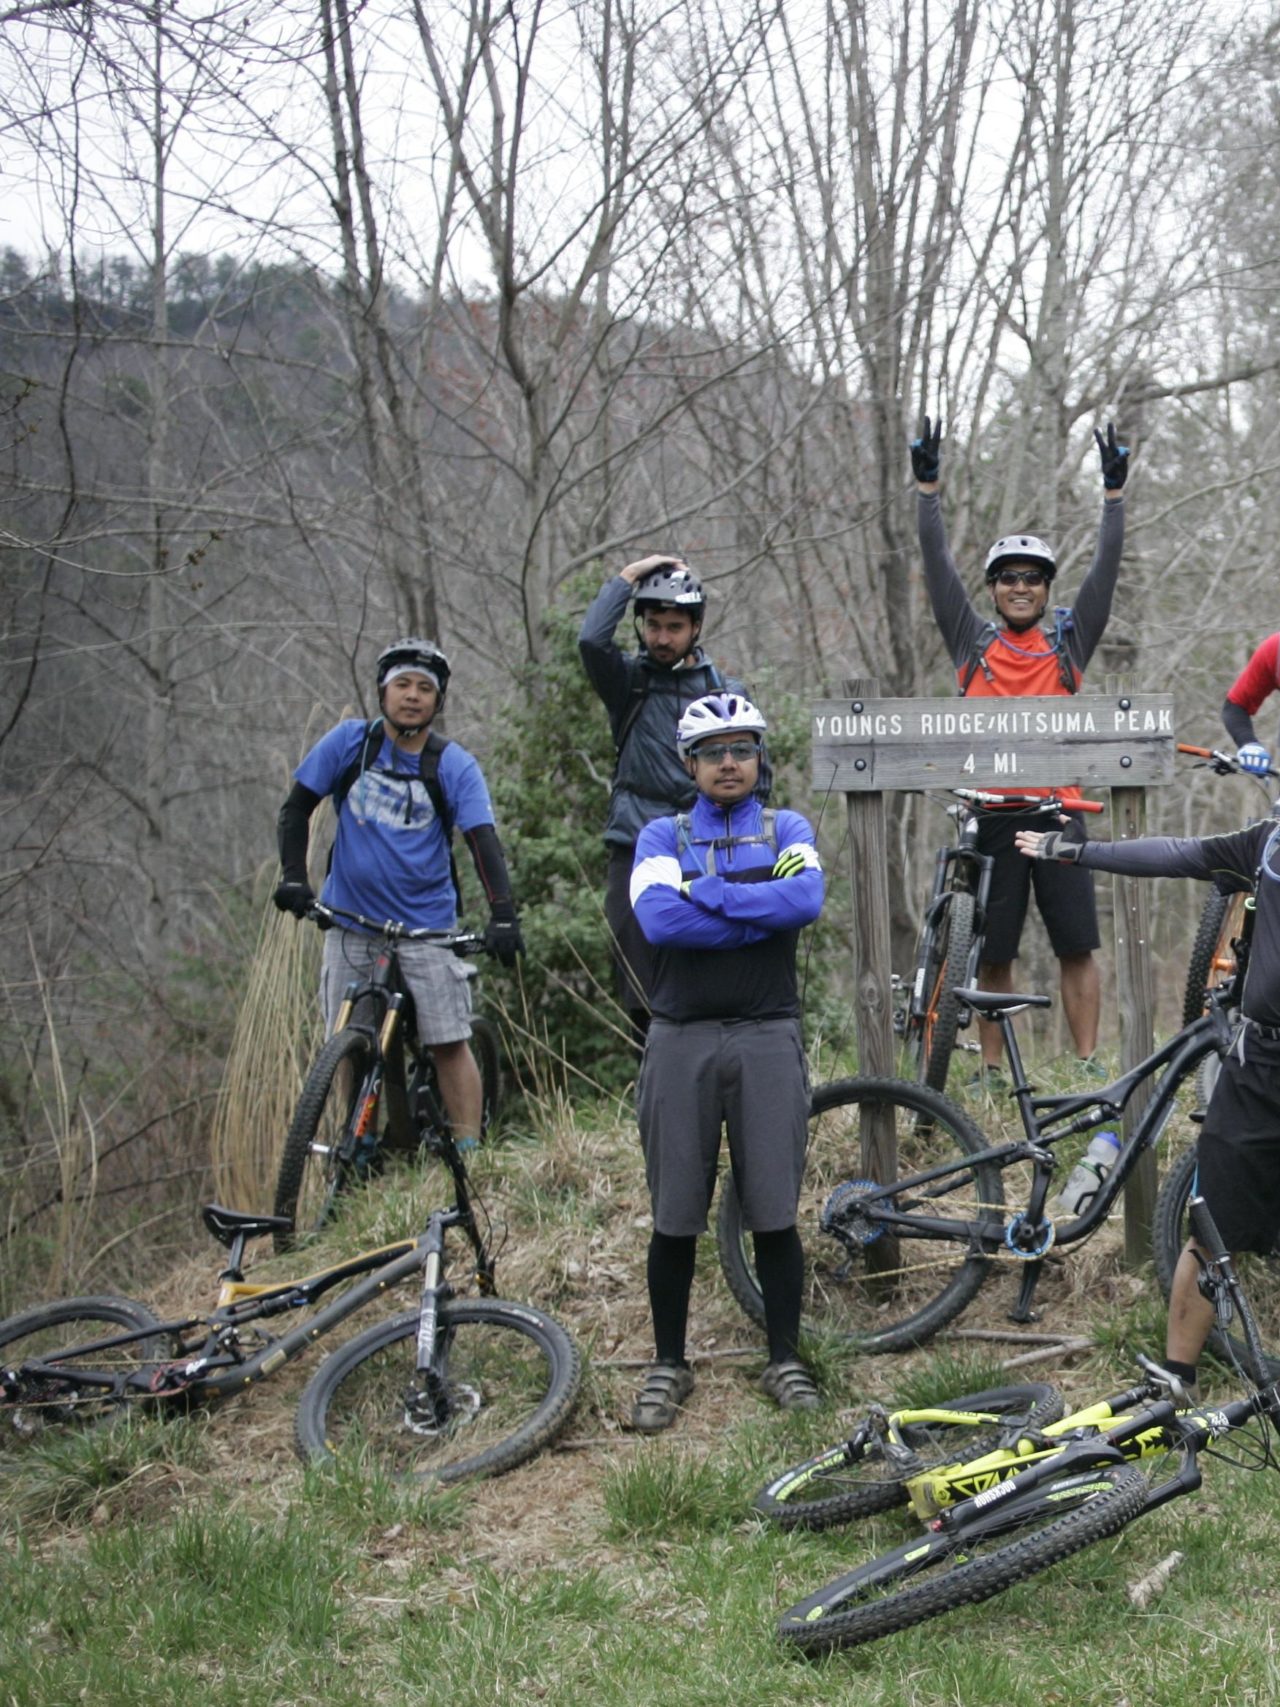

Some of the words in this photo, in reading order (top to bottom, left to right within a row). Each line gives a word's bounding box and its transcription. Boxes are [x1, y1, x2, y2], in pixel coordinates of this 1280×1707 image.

[815, 714, 902, 737] YOUNGS
[1114, 709, 1172, 732] PEAK
[963, 752, 976, 774] 4
